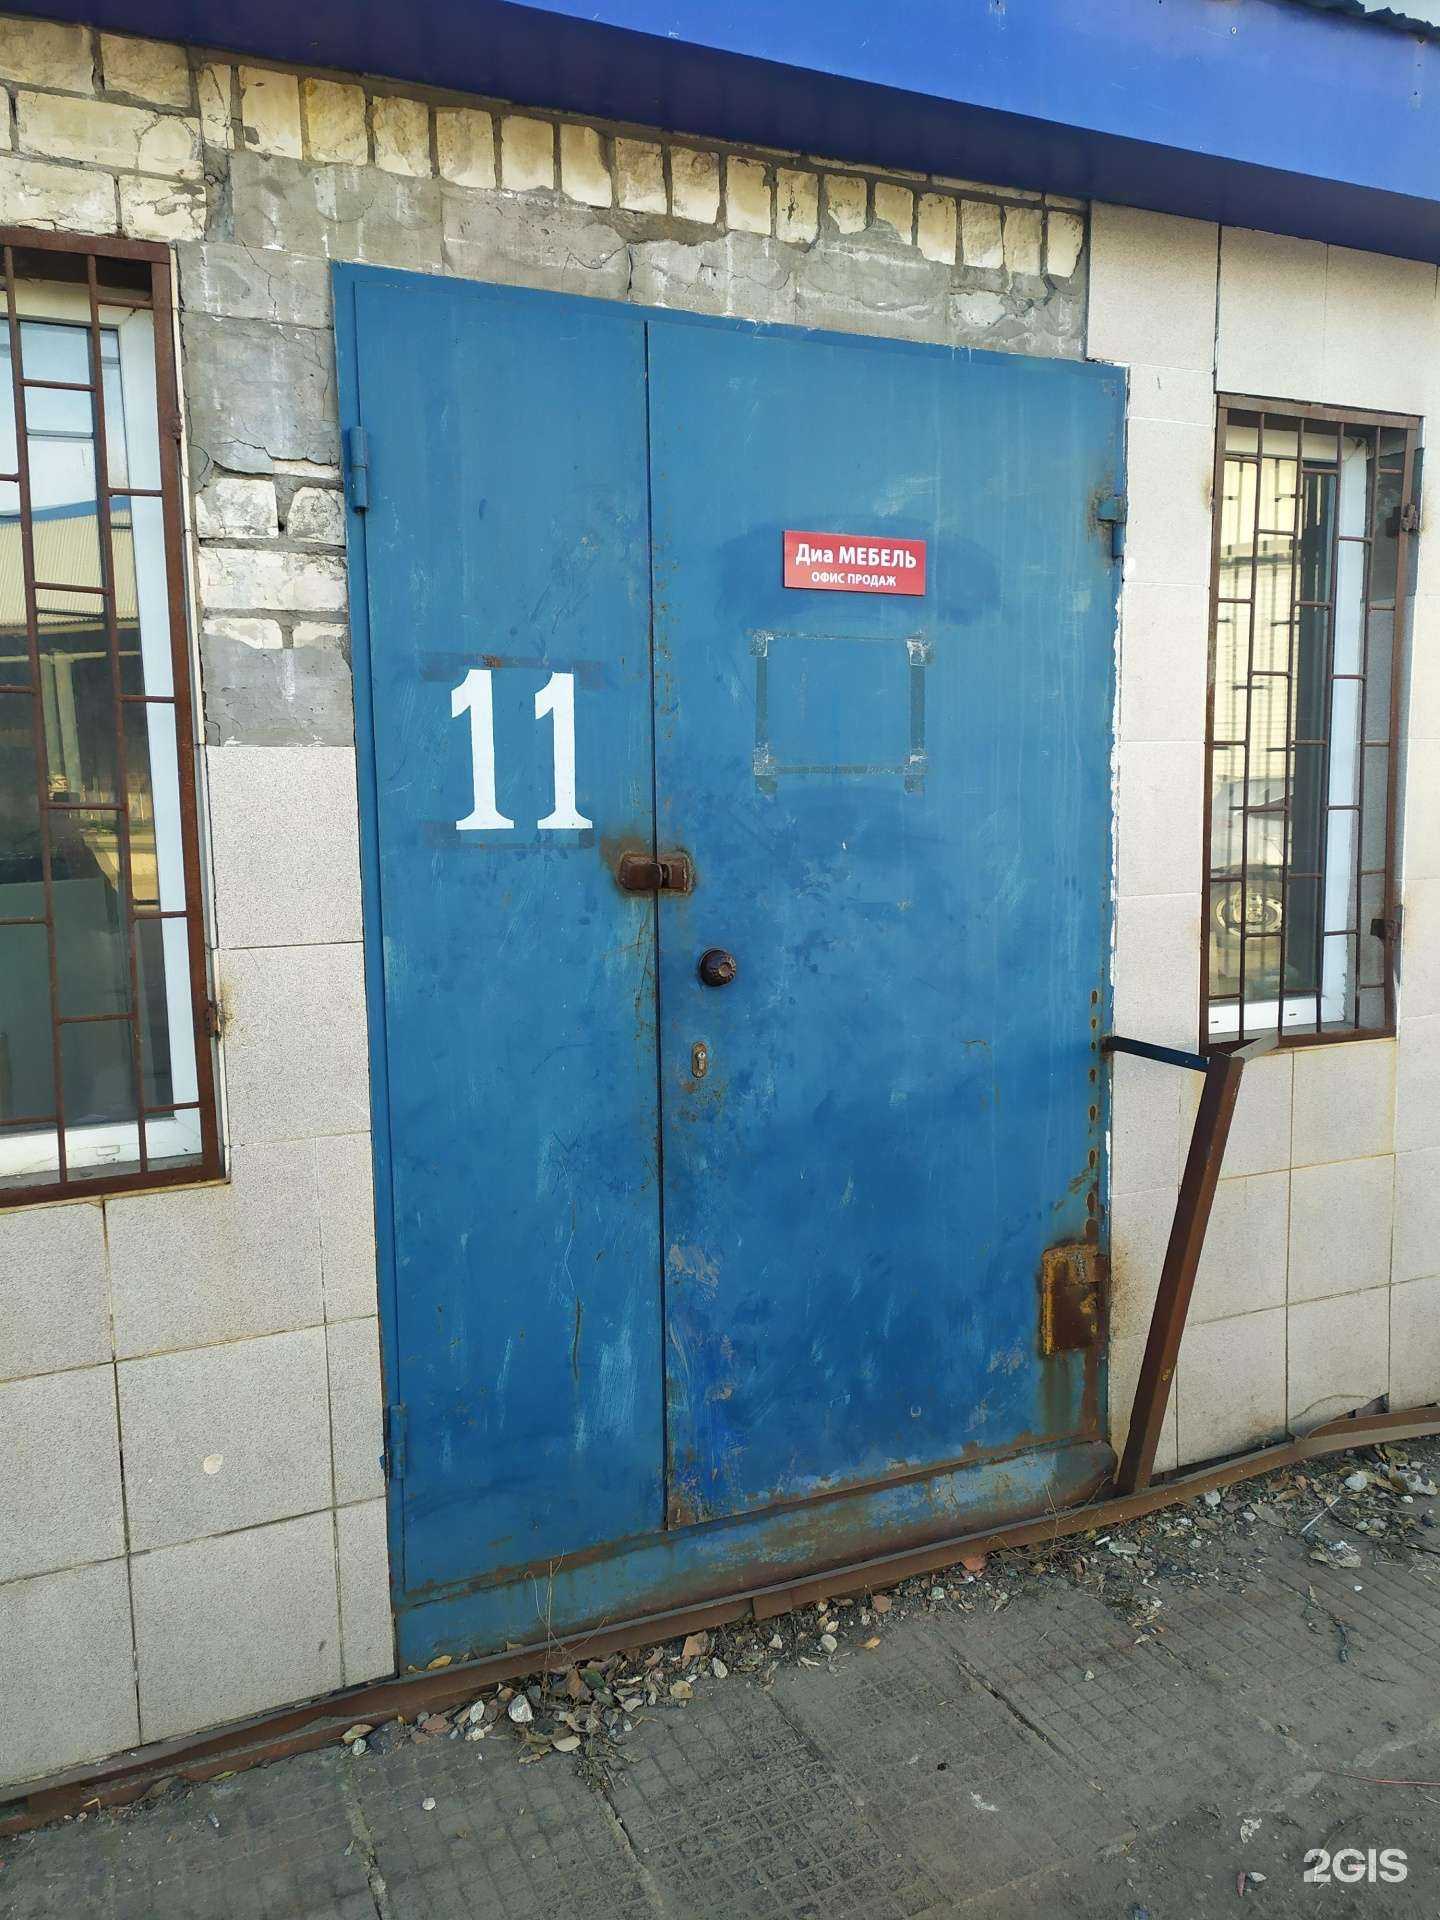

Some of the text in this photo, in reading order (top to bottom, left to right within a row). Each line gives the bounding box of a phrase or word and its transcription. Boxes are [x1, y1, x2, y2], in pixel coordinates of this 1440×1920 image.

[795, 543, 917, 569] Диа МЕБЕЛЬ
[811, 571, 897, 588] ОФИС ПРОДАЖ
[451, 669, 593, 830] 11
